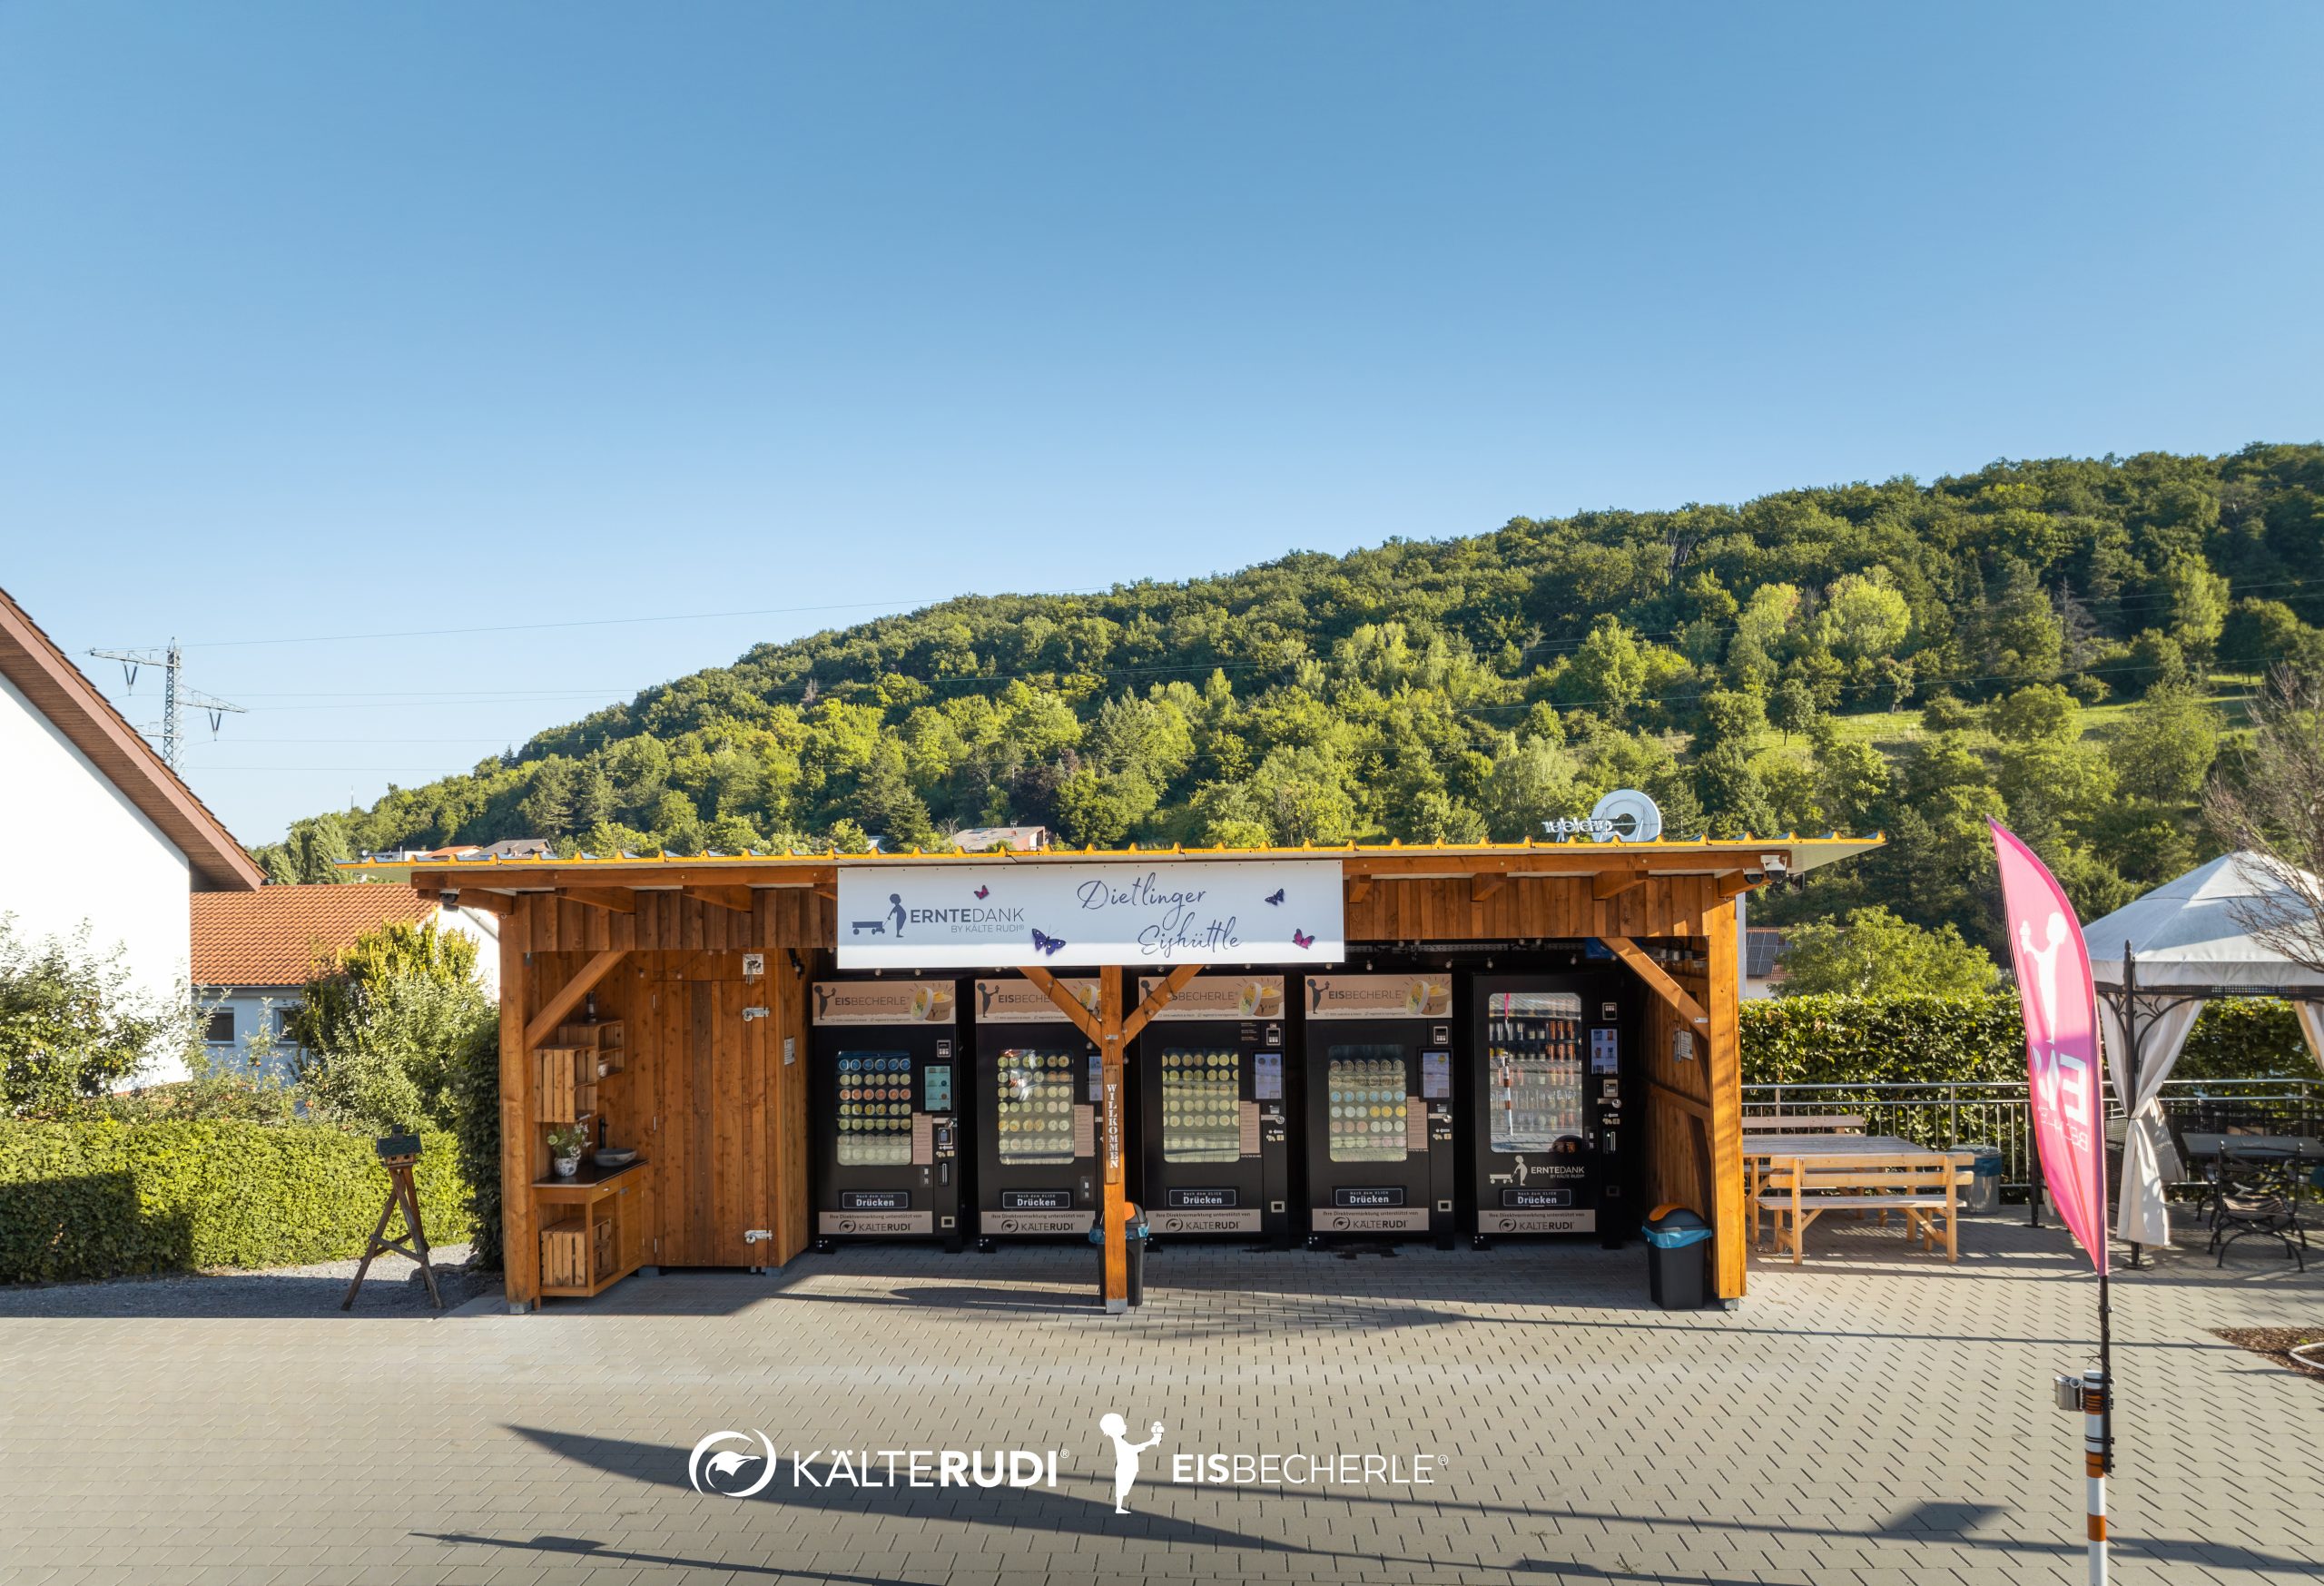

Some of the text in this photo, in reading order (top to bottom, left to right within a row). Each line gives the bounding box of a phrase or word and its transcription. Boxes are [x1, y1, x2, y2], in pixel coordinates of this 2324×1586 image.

[1077, 872, 1206, 931] Dietlinger
[911, 908, 1024, 923] ERNTEDANK
[950, 925, 962, 933] BY
[965, 924, 993, 933] KÄLTE
[999, 994, 1051, 1003] EISBECHE
[1107, 1083, 1118, 1169] WILLKOMMEN
[1531, 1166, 1585, 1174] ERNTEDANK
[856, 1198, 894, 1207] Drücken
[1017, 1198, 1056, 1207] Drücken
[1183, 1197, 1222, 1205] Drücken
[1350, 1196, 1389, 1204] Drücken
[1518, 1196, 1557, 1204] Drücken
